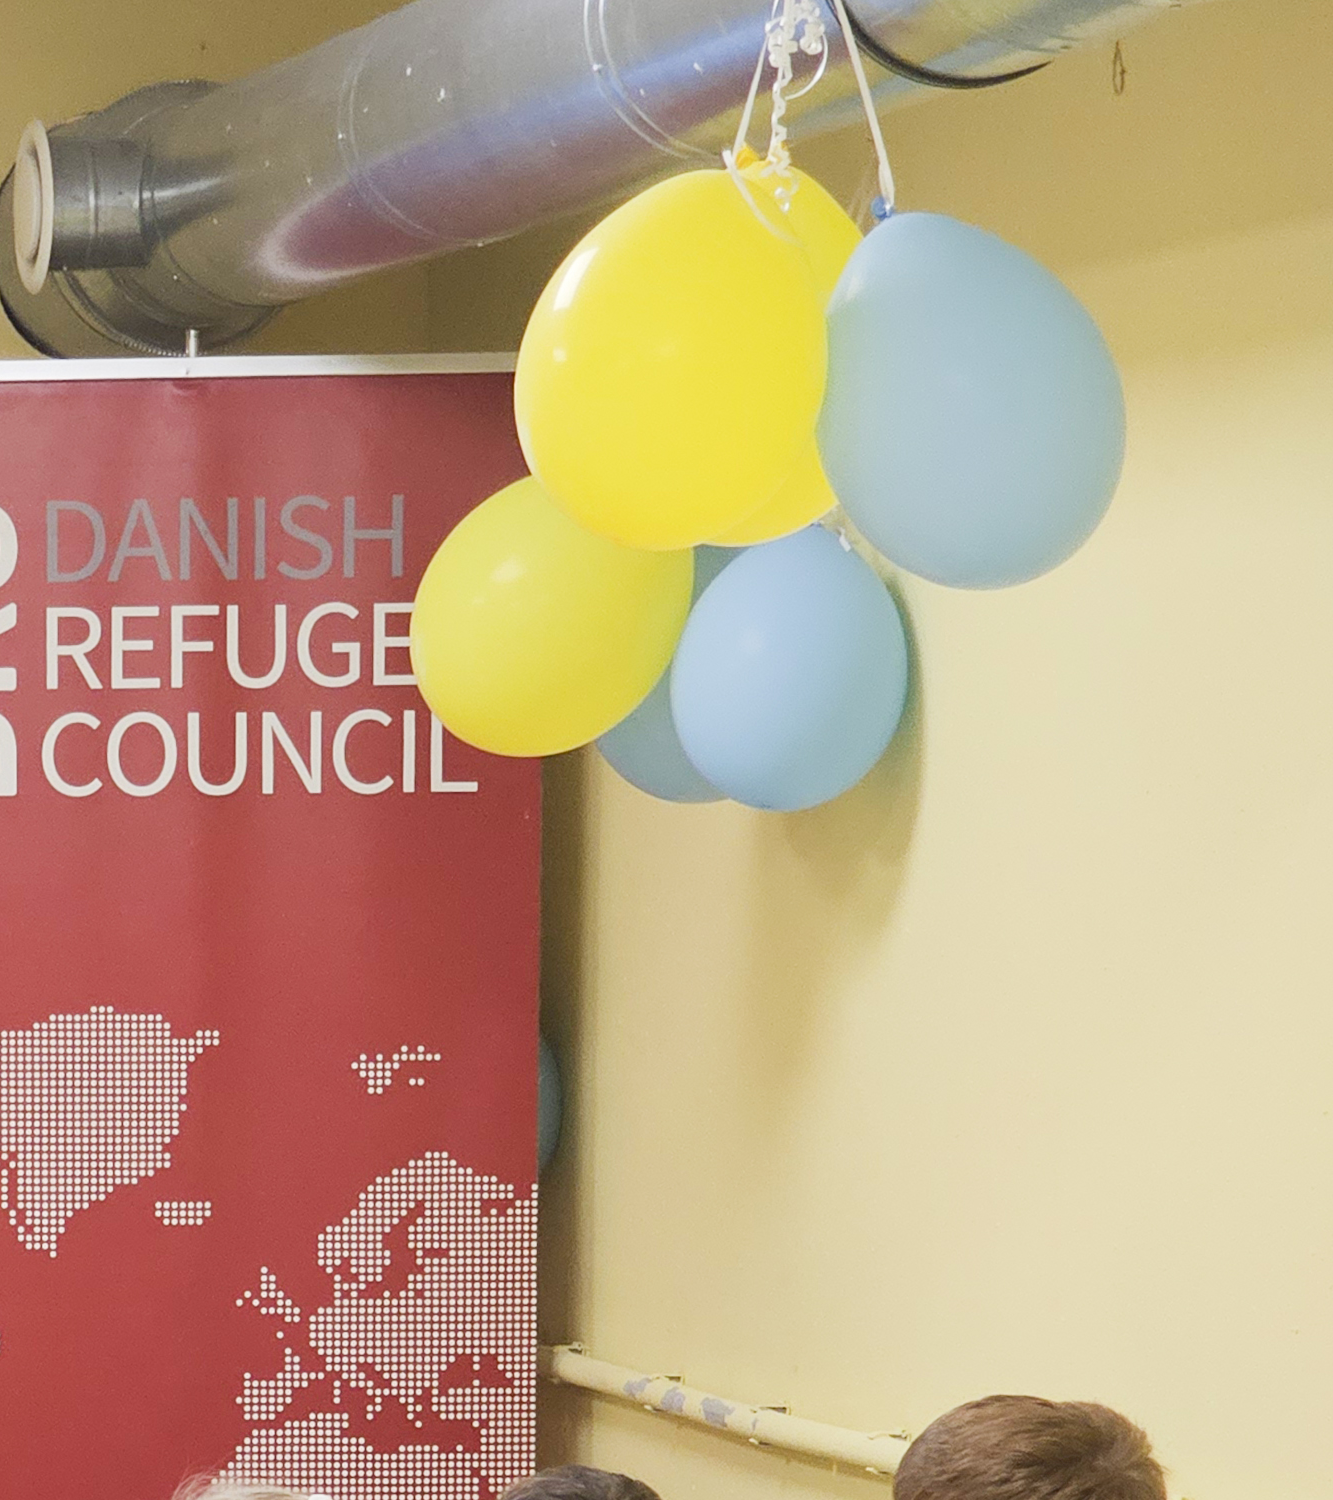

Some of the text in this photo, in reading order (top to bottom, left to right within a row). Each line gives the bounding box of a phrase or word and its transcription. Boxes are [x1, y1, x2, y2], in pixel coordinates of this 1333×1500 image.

[46, 495, 405, 583] DANISH
[46, 602, 417, 690] REFUGE
[42, 709, 478, 797] COUNCIL
